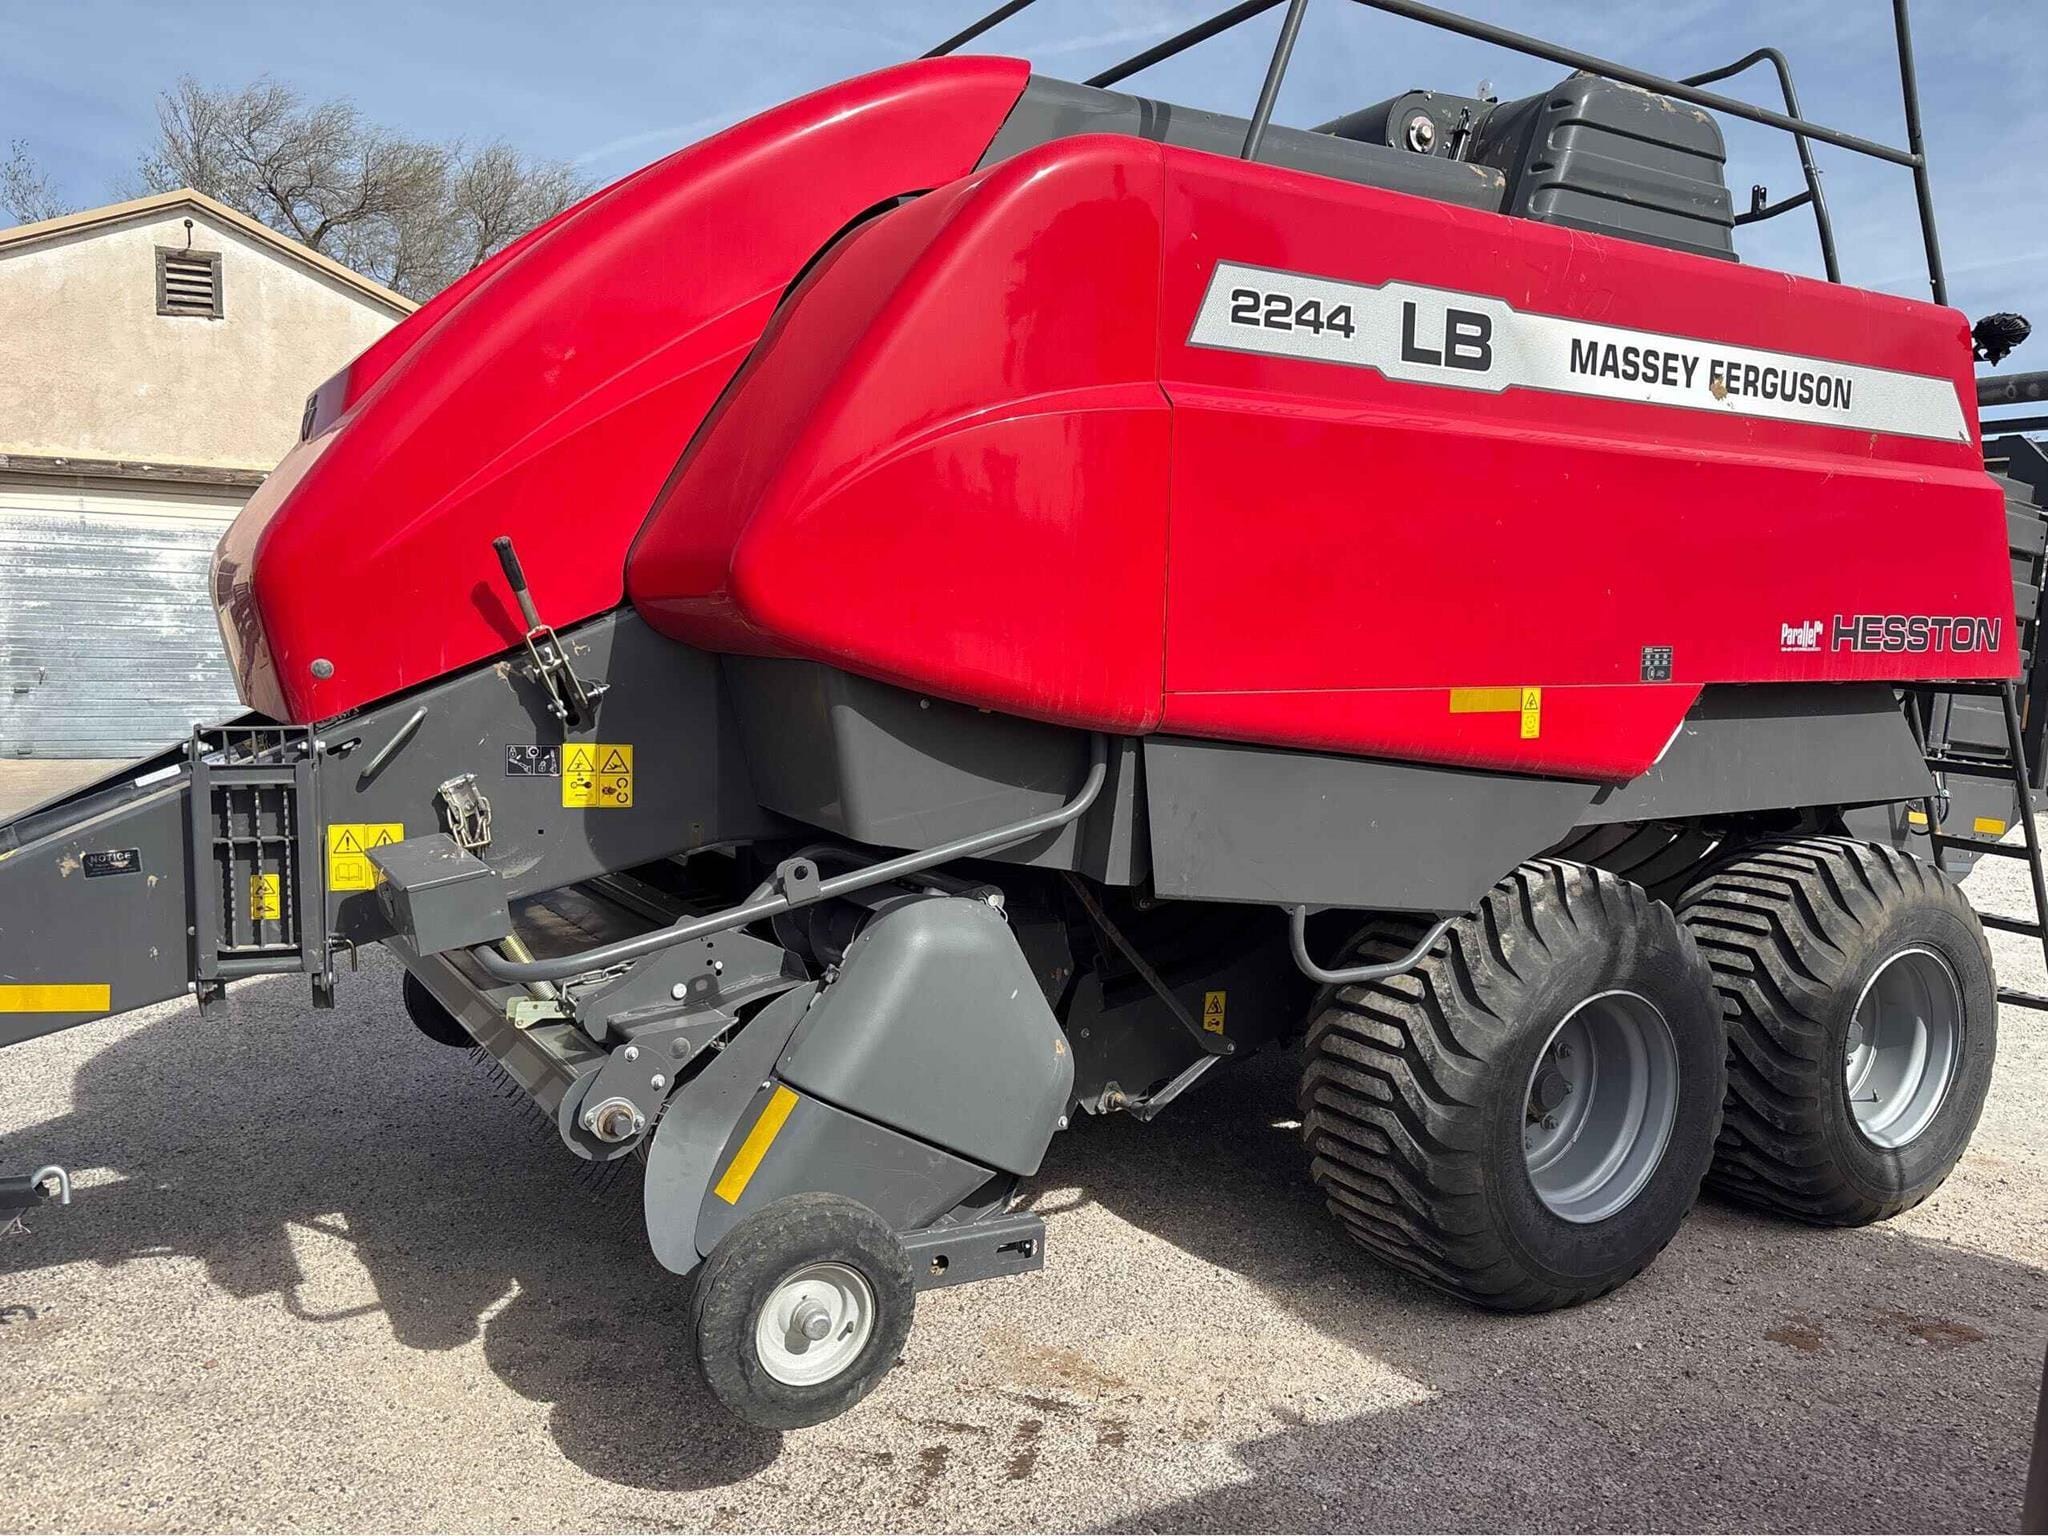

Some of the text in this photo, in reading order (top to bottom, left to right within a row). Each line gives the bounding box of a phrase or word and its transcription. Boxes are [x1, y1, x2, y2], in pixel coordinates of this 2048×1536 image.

[1231, 289, 1852, 410] 2244 LB MASSEY FERGUSON
[1831, 615, 2001, 652] HESSTON
[90, 852, 131, 863] NOTICE
